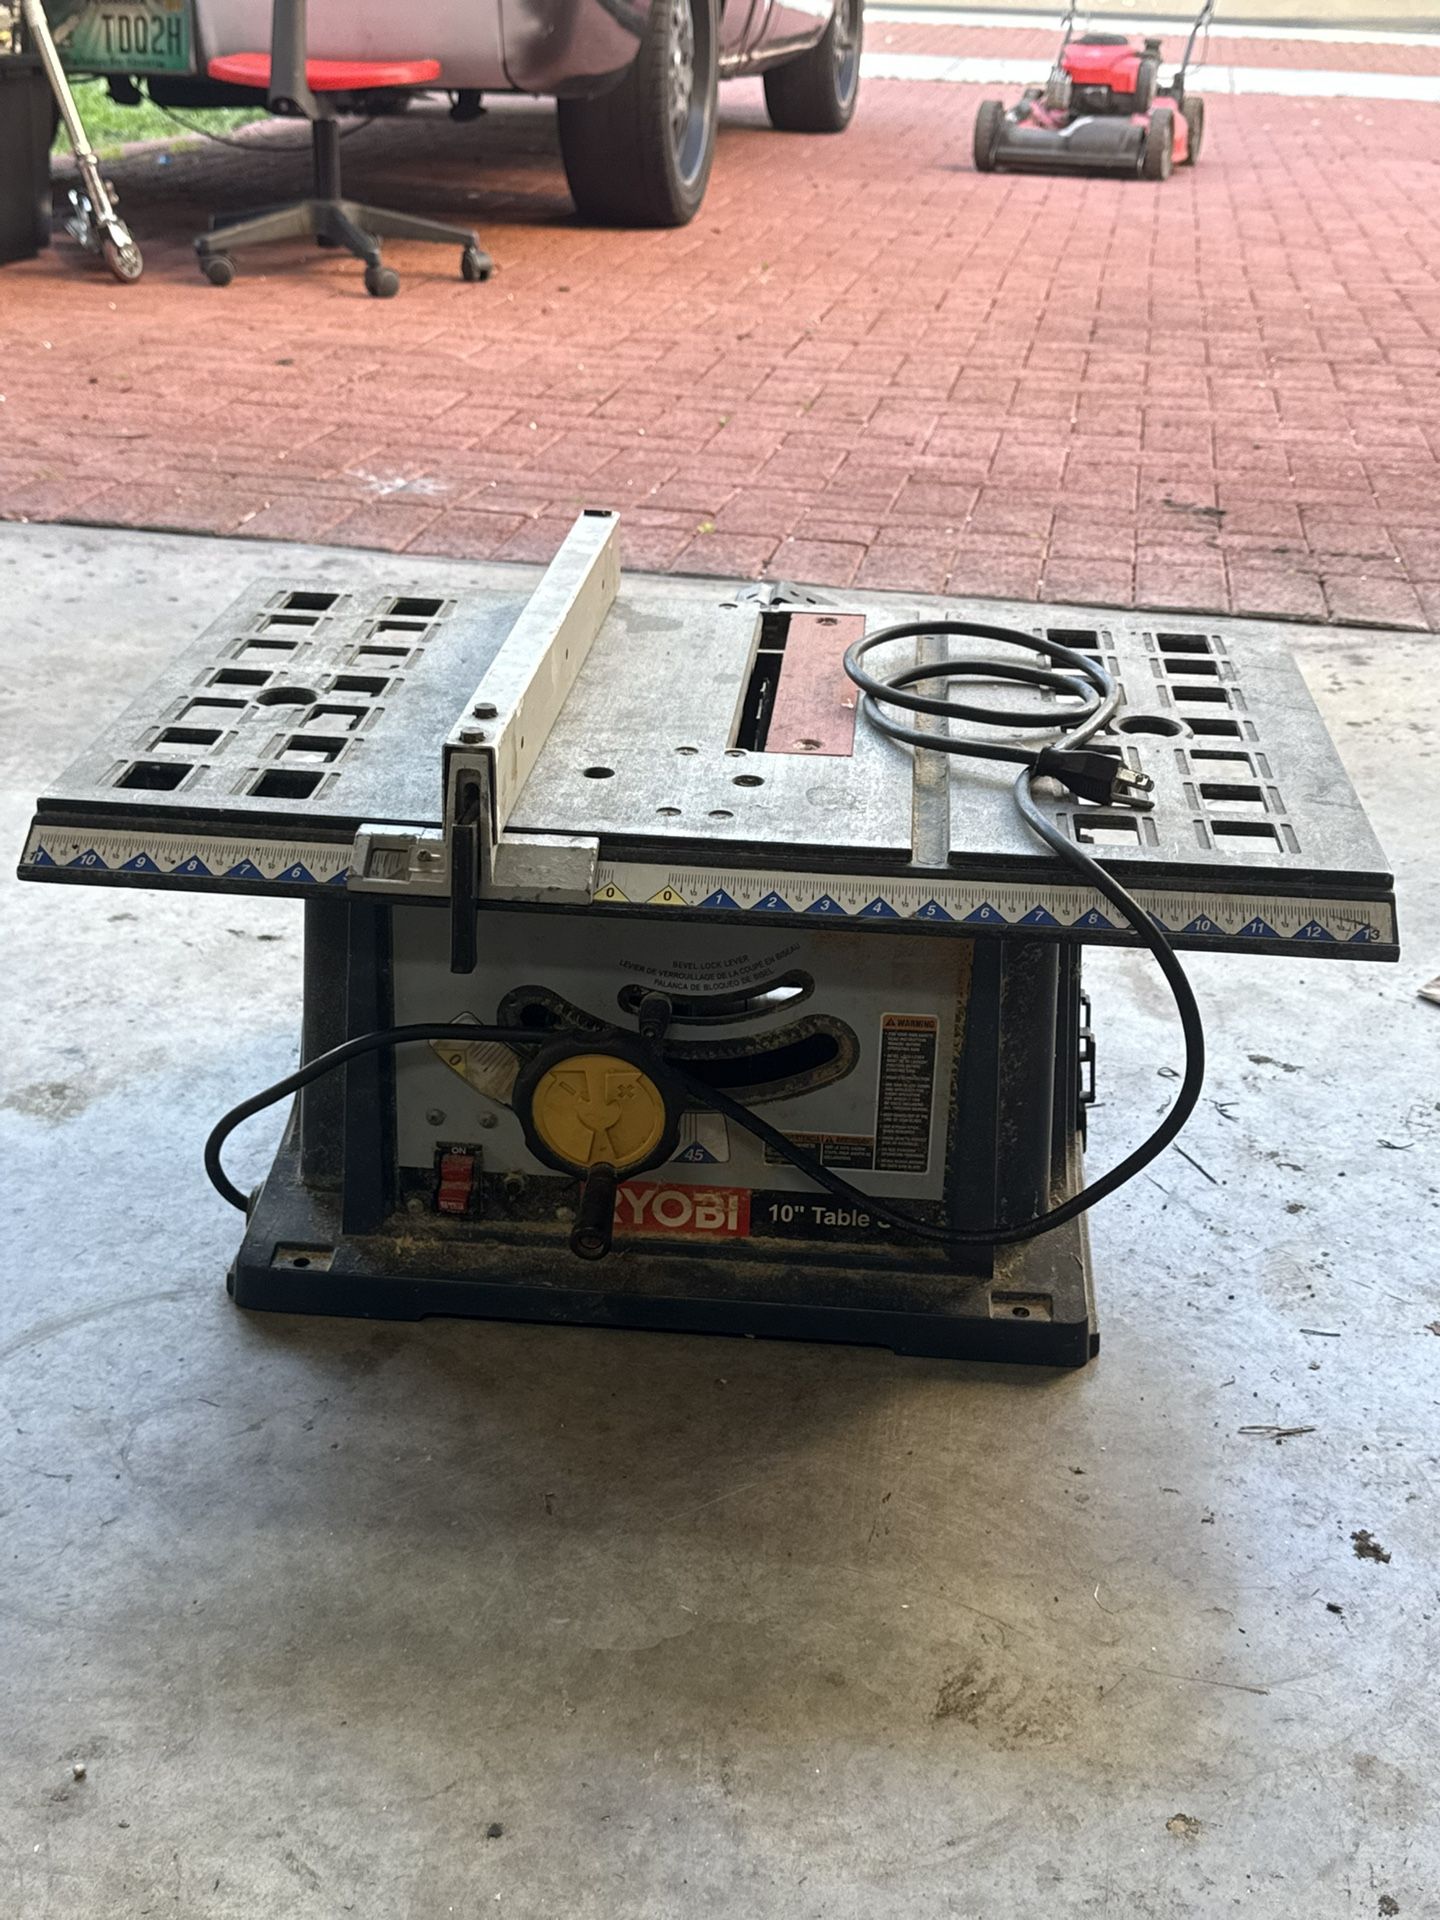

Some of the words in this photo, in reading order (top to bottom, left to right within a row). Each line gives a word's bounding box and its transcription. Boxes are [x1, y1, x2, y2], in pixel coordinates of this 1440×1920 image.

[80, 855, 97, 866] 10
[137, 857, 147, 868] 9
[188, 860, 199, 871] 8
[240, 864, 250, 875] 7
[291, 867, 302, 878] 6
[606, 887, 615, 898] 0
[663, 890, 673, 901] 0
[716, 894, 723, 904] 1
[767, 896, 777, 908] 2
[820, 900, 831, 911] 3
[873, 902, 883, 912] 4
[927, 905, 937, 915] 5
[980, 908, 991, 918] 6
[1035, 911, 1045, 921] 7
[1088, 914, 1099, 924] 8
[1194, 919, 1210, 931] 10
[1250, 922, 1265, 933] 11
[1304, 925, 1322, 937] 12
[1363, 929, 1381, 941] 13
[646, 967, 657, 975] DE
[716, 972, 727, 980] DE
[728, 969, 739, 978] LA
[740, 961, 764, 975] COUPE
[764, 956, 776, 967] EN
[672, 960, 698, 970] BEVEL
[701, 961, 721, 970] LOCK
[724, 954, 749, 968] LEVER
[654, 978, 688, 989] PALANCA
[691, 983, 700, 991] DE
[703, 979, 740, 991] BLOQUEO
[741, 976, 752, 985] DE
[449, 1054, 462, 1066] 0
[451, 1146, 467, 1155] ON
[685, 1149, 705, 1161] 45
[769, 1204, 805, 1224] 10"
[811, 1206, 871, 1228] Table
